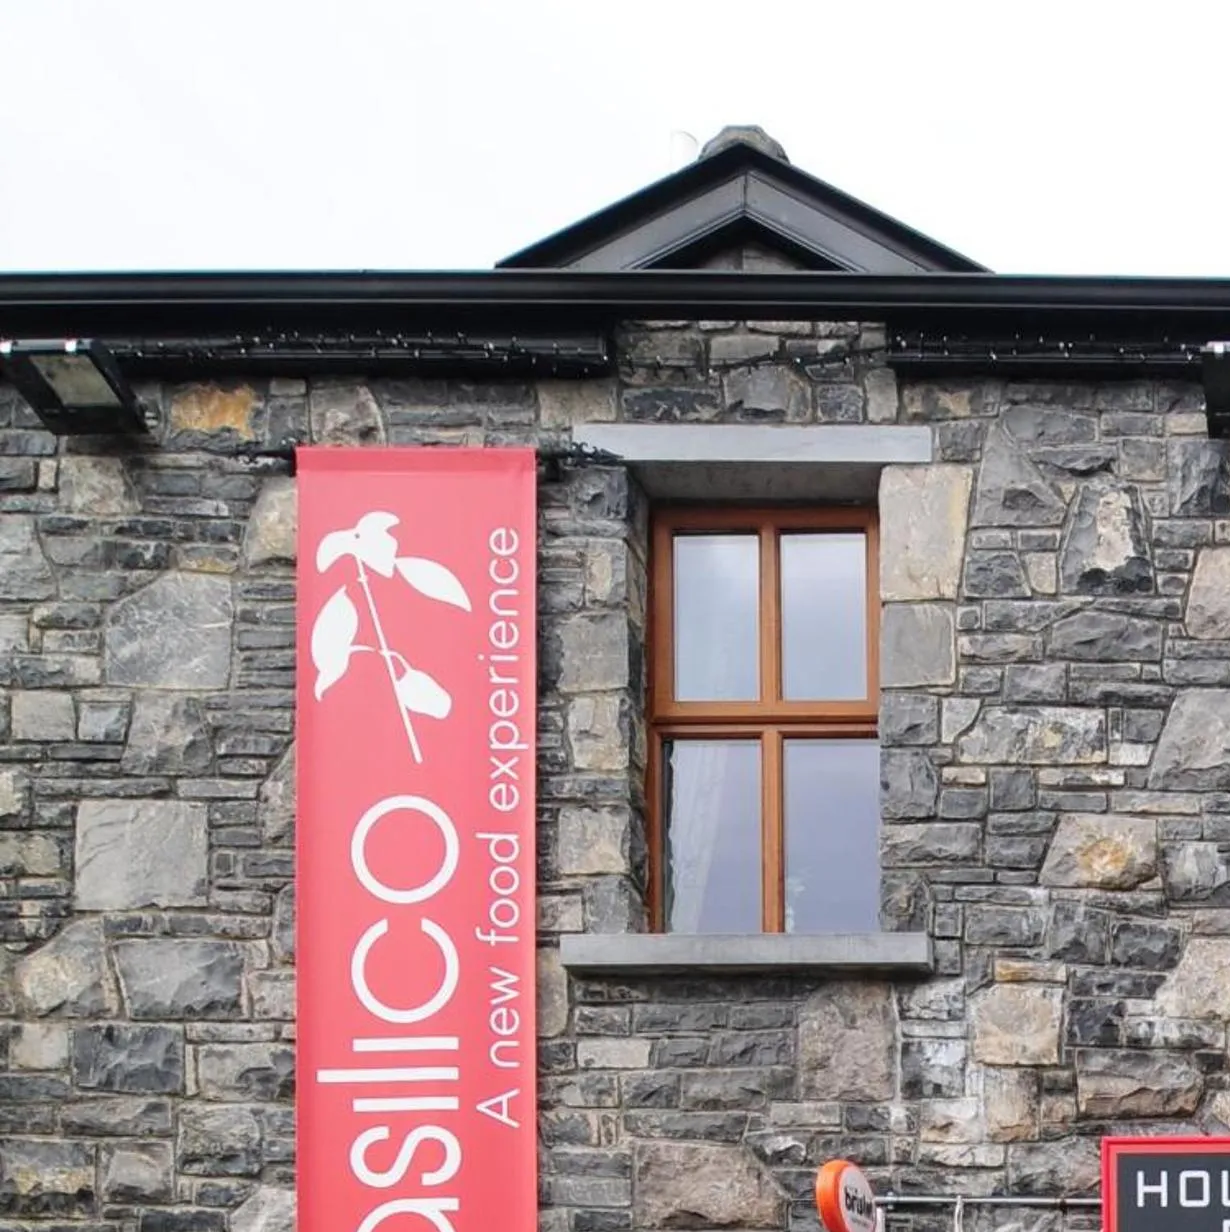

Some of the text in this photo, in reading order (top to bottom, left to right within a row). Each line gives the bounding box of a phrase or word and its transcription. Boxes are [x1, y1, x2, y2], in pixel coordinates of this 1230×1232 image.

[475, 527, 530, 1128] A new food experience
